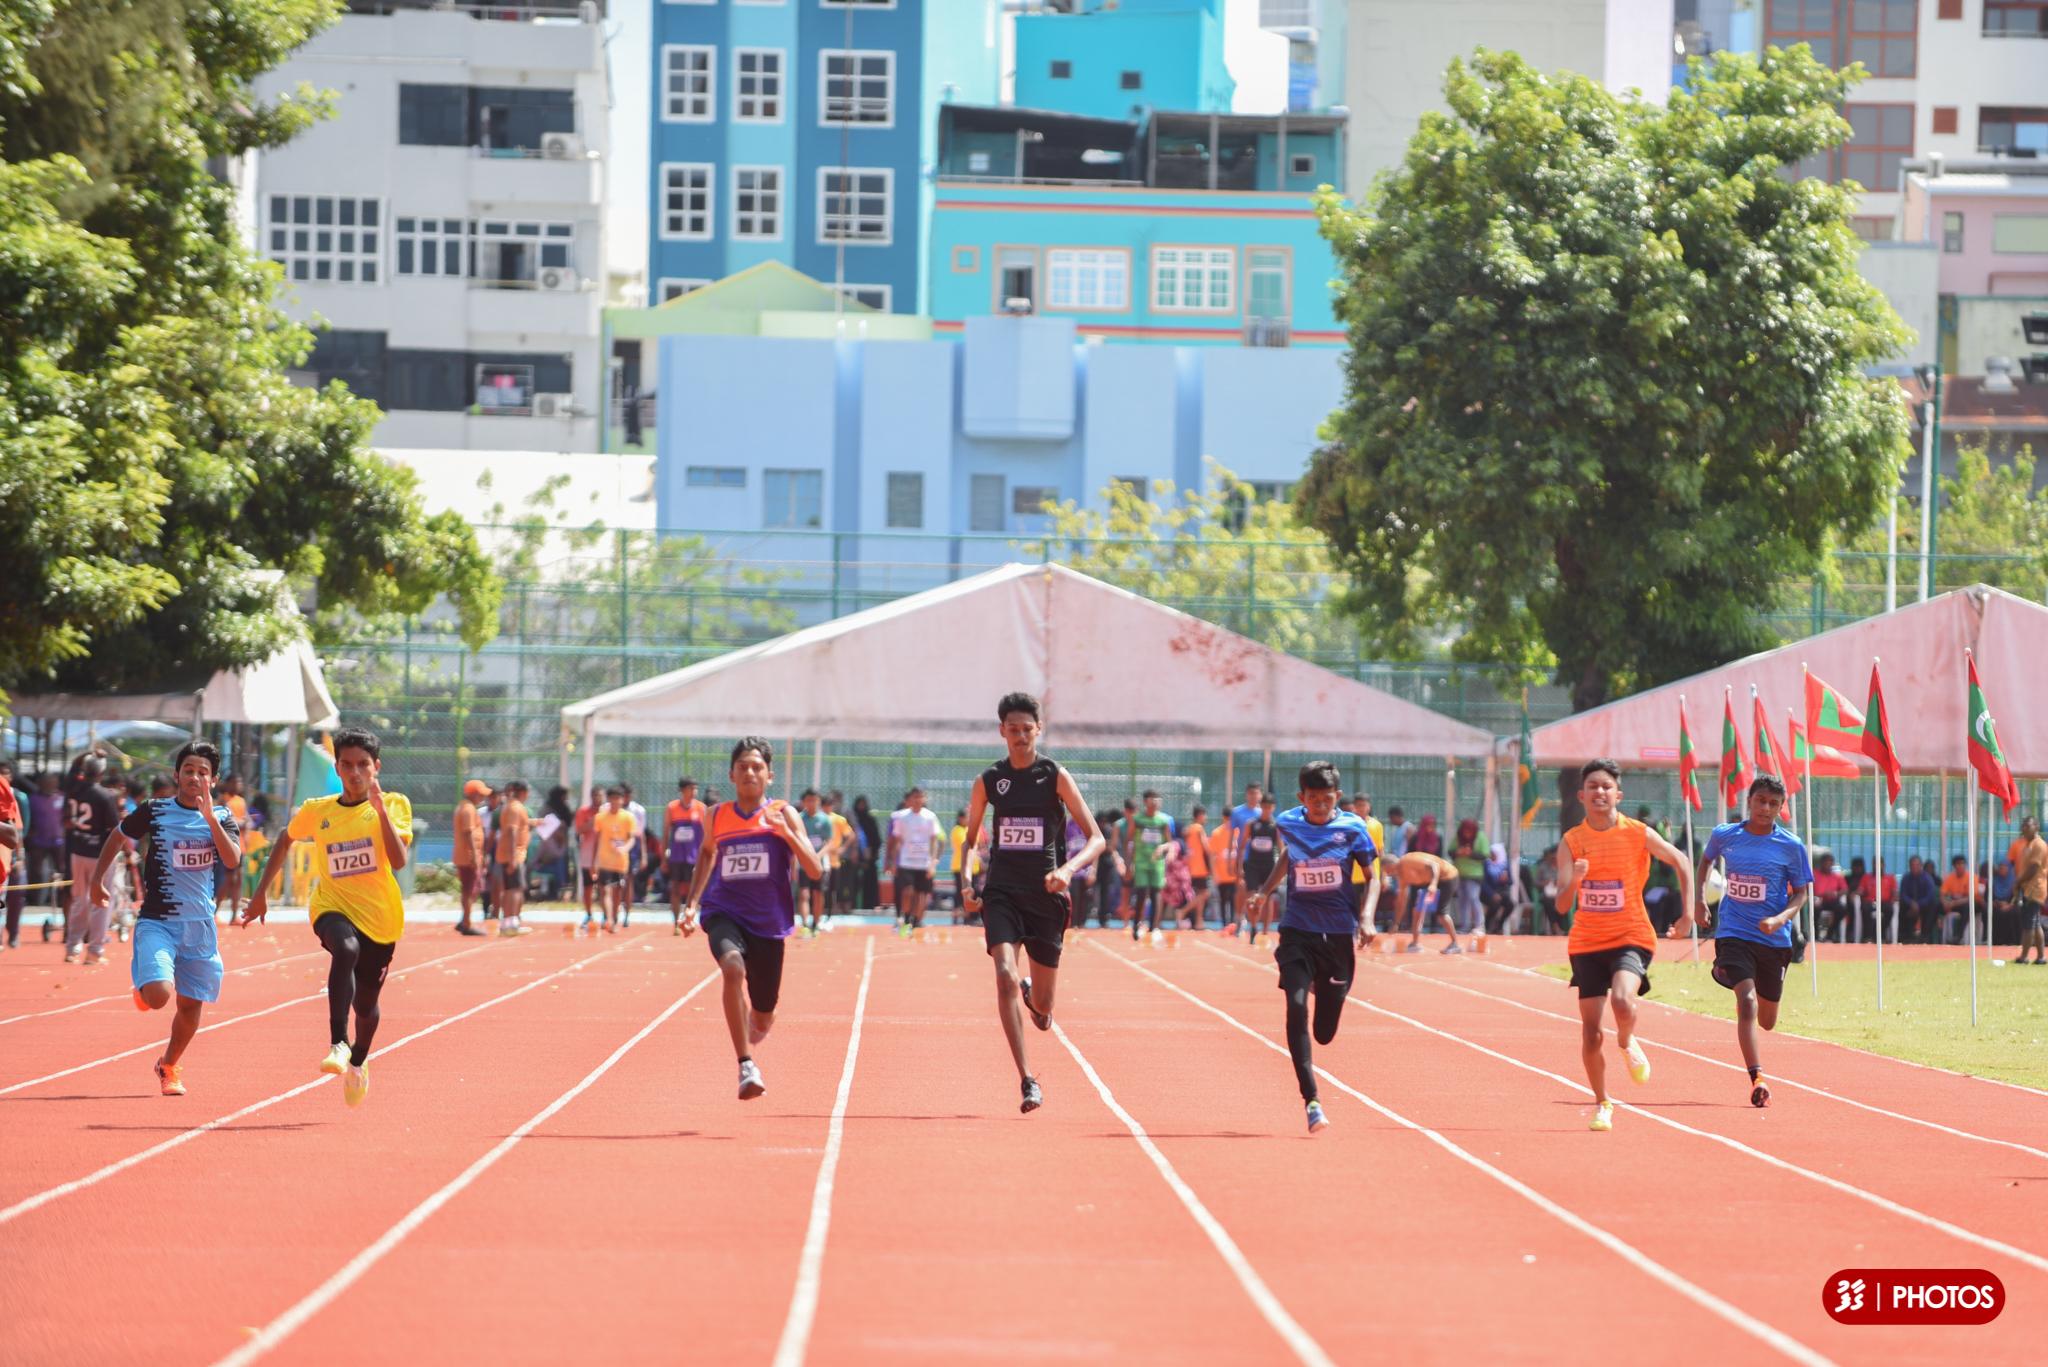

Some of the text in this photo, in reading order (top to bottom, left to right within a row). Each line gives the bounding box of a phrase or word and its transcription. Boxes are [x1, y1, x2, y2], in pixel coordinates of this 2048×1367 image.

[1003, 829, 1035, 843] 579
[179, 852, 212, 866] 1610
[333, 853, 370, 870] 1720
[728, 856, 762, 873] 797
[1302, 871, 1335, 885] 1318
[1730, 883, 1760, 898] 508
[1585, 893, 1617, 906] 1923
